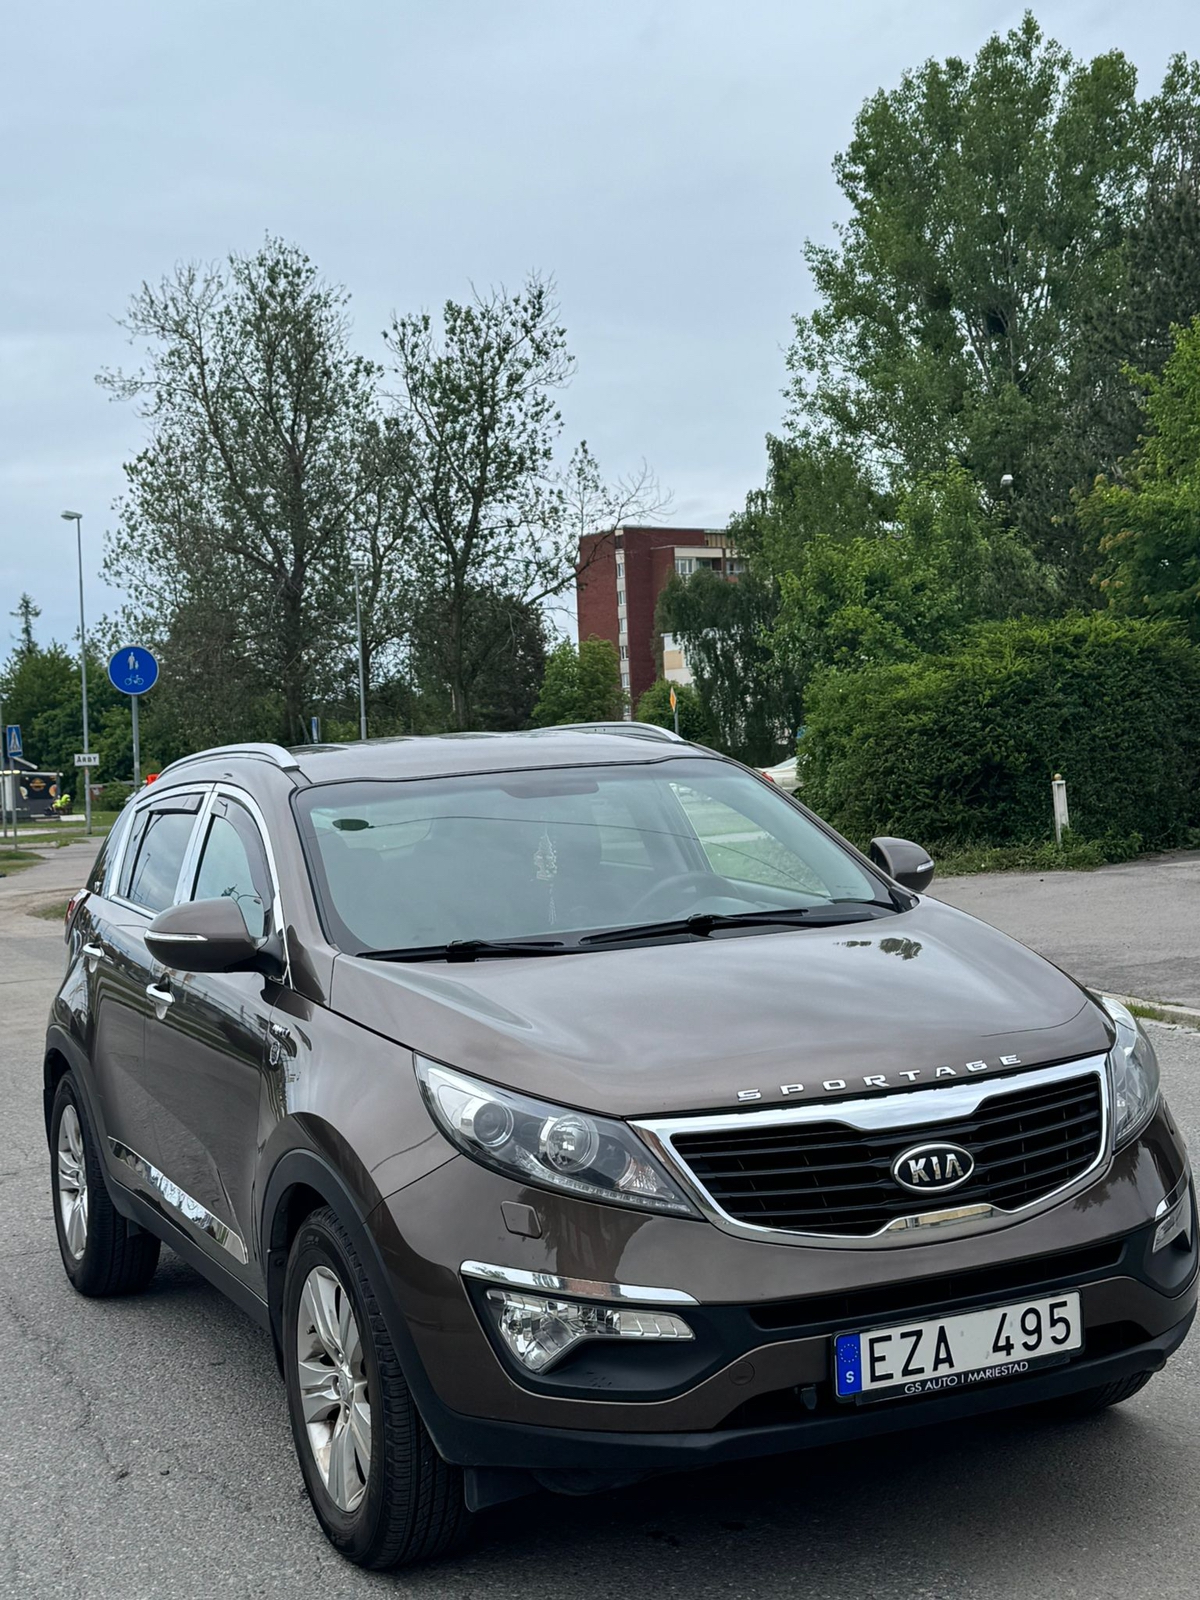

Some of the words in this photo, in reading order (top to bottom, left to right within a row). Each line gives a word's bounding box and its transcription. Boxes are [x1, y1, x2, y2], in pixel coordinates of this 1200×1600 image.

[737, 1054, 1022, 1101] SPORTAGE
[907, 1153, 964, 1184] KIA
[868, 1325, 955, 1383] EZA
[992, 1300, 1071, 1357] 495
[845, 1371, 855, 1383] S
[904, 1382, 922, 1394] GS
[924, 1376, 958, 1390] AUTO
[967, 1361, 1029, 1382] MARIESTAD
